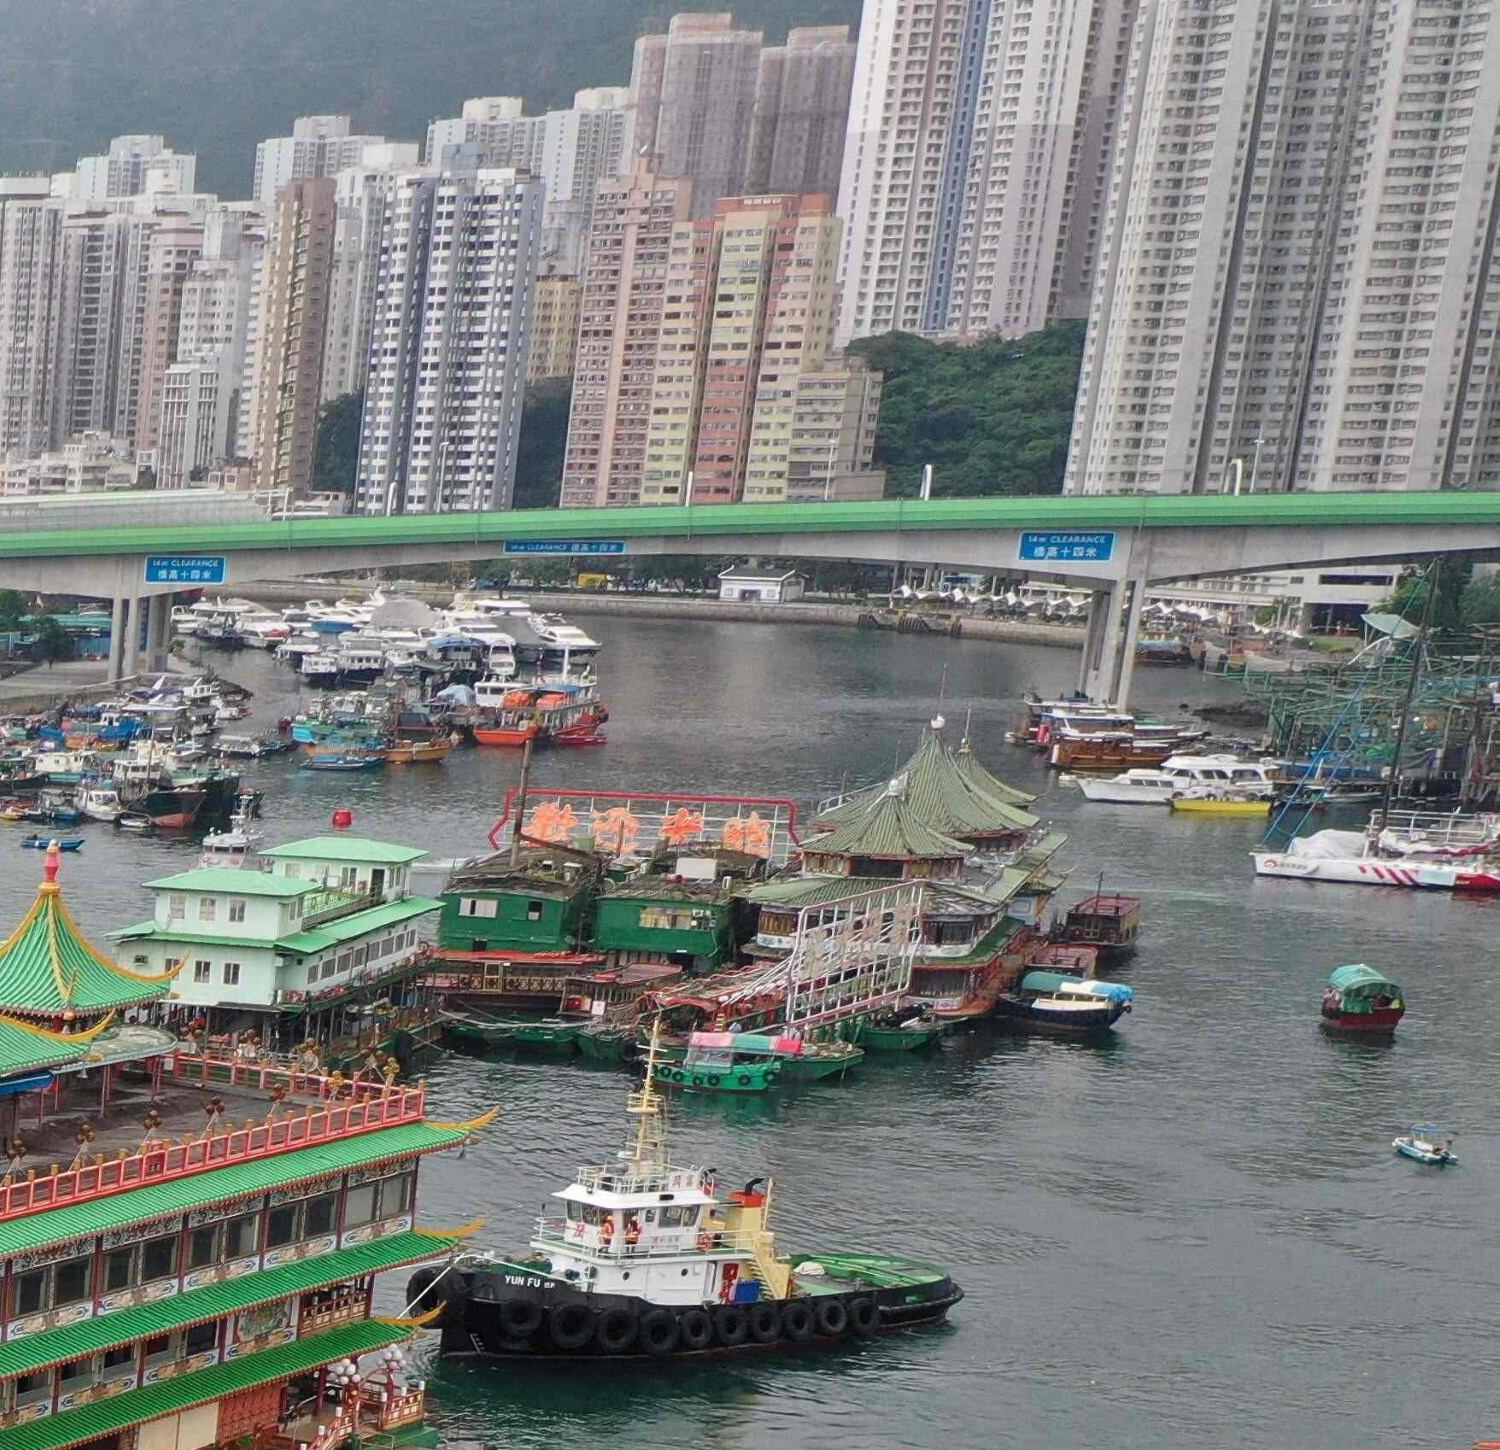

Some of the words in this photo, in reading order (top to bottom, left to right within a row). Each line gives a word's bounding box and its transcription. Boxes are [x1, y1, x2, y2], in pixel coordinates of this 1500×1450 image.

[1050, 536, 1105, 544] CLEARANCE
[505, 1275, 525, 1286] YUN
[527, 1277, 541, 1287] FU
